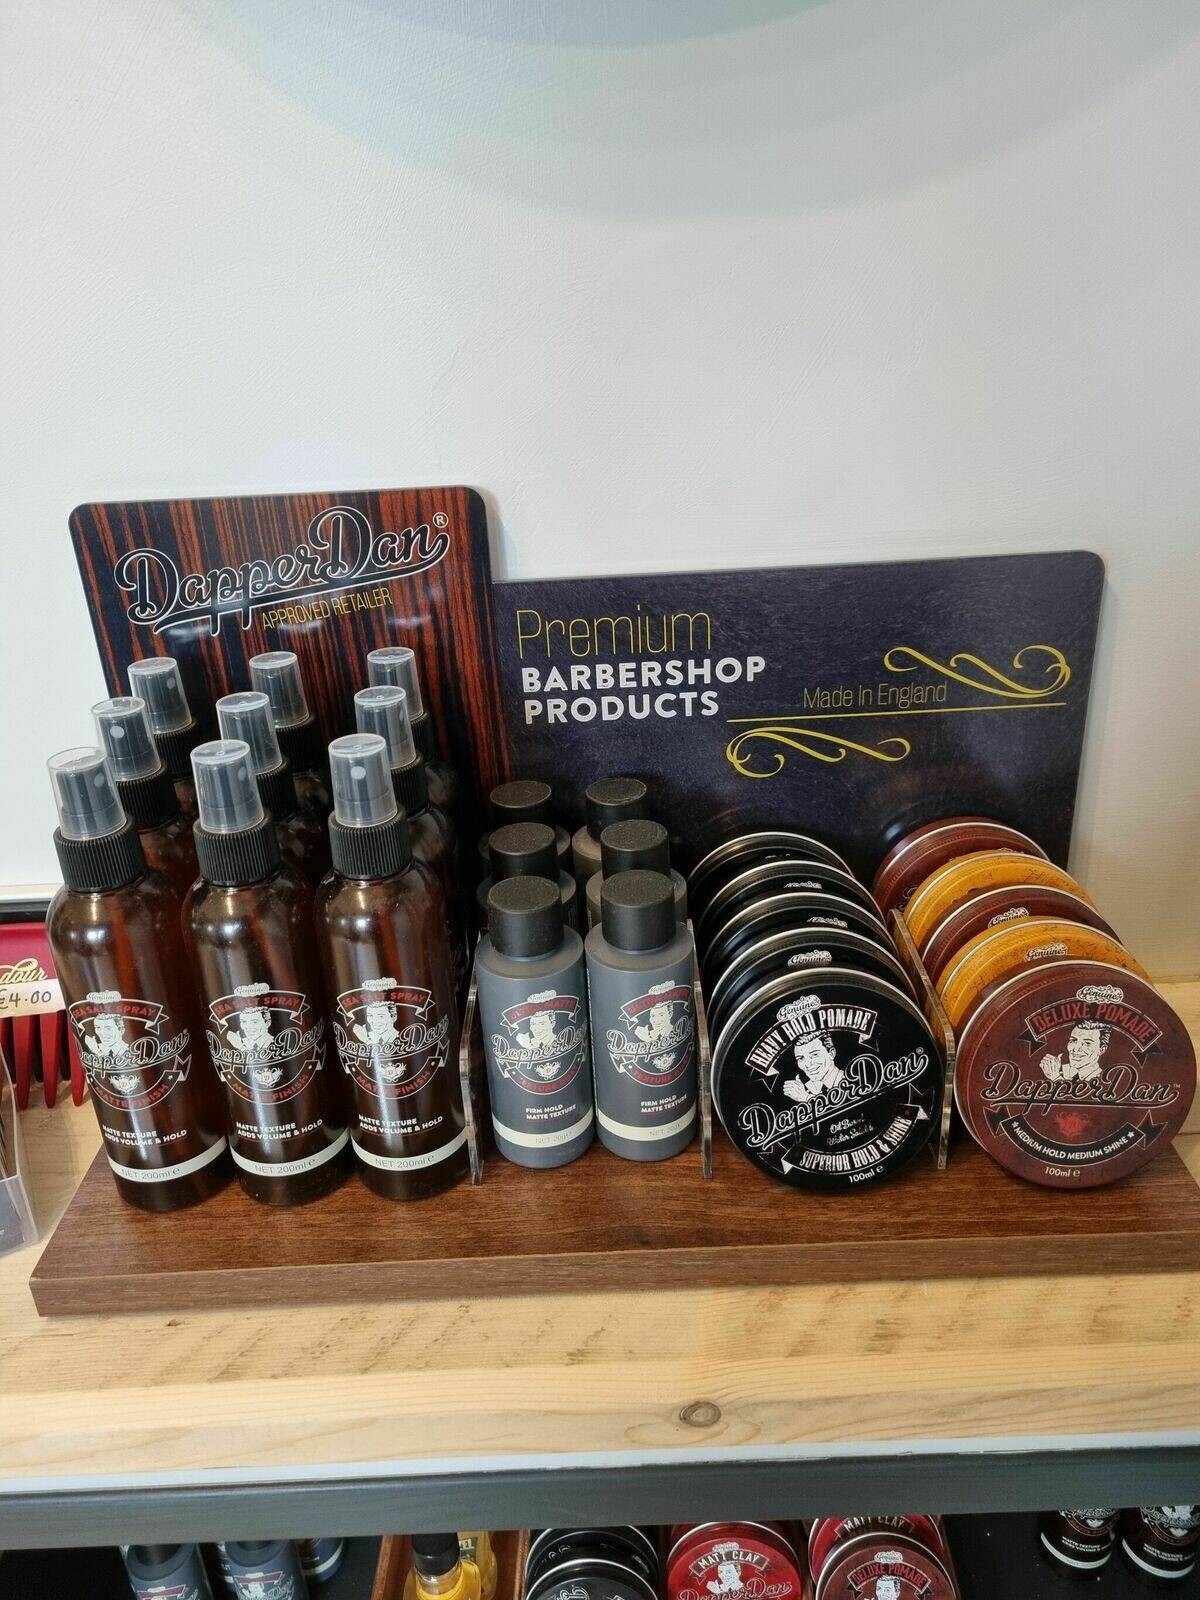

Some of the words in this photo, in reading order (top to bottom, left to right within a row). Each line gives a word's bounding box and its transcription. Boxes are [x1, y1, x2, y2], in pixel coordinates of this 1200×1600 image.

[262, 600, 330, 630] APPROVED
[331, 587, 393, 615] RETAILER
[515, 604, 712, 658] Premium
[521, 655, 766, 693] BARBERSHOP
[803, 685, 852, 708] Made
[858, 685, 872, 706] In
[877, 681, 948, 709] England
[524, 691, 719, 724] PRODUCTS
[263, 996, 301, 1009] SPRAY
[390, 991, 428, 1003] SPRAY
[1033, 1003, 1091, 1032] DELUXE
[1097, 1003, 1153, 1043] POMADE
[750, 1030, 787, 1068] HEAVY
[781, 1013, 816, 1041] HOLD
[818, 1009, 871, 1031] POMADE
[980, 1060, 1102, 1116] Dapper
[544, 1104, 563, 1114] HOLD
[659, 1095, 677, 1105] HOLD
[664, 1094, 688, 1111] TEXTURE
[359, 1114, 380, 1126] MATTE
[382, 1118, 417, 1127] TEXTURE
[526, 1113, 549, 1121] MATTE
[549, 1104, 577, 1119] TEXTURE
[738, 1079, 857, 1149] Dapper
[122, 1130, 157, 1138] TEXTURE
[236, 1121, 258, 1132] MATTE
[260, 1122, 296, 1132] TEXTURE
[238, 1130, 256, 1139] ADDS
[256, 1131, 292, 1140] VOLUME
[301, 1119, 323, 1134] HOLD
[360, 1121, 378, 1132] ADDS
[378, 1126, 412, 1134] VOLUME
[422, 1116, 443, 1129] HOLD
[883, 1115, 912, 1146] SHINE
[121, 1138, 153, 1146] VOLUME
[163, 1129, 188, 1142] HOLD
[876, 1140, 891, 1153] &
[1014, 1127, 1042, 1151] MEDIUM
[1042, 1147, 1066, 1159] HOLD
[1067, 1149, 1103, 1160] MEDIUM
[1103, 1136, 1128, 1153] SHINE
[375, 1158, 395, 1168] NET
[799, 1149, 851, 1171] SUPERIOR
[851, 1144, 880, 1168] HOLD
[254, 1164, 274, 1174] NET
[849, 1168, 875, 1183] 100ml
[1044, 1166, 1070, 1177] 100ml
[698, 1551, 726, 1569] MATT
[732, 1551, 760, 1563] CLAY
[853, 1563, 886, 1583] DELUXE
[888, 1563, 928, 1587] POMADE
